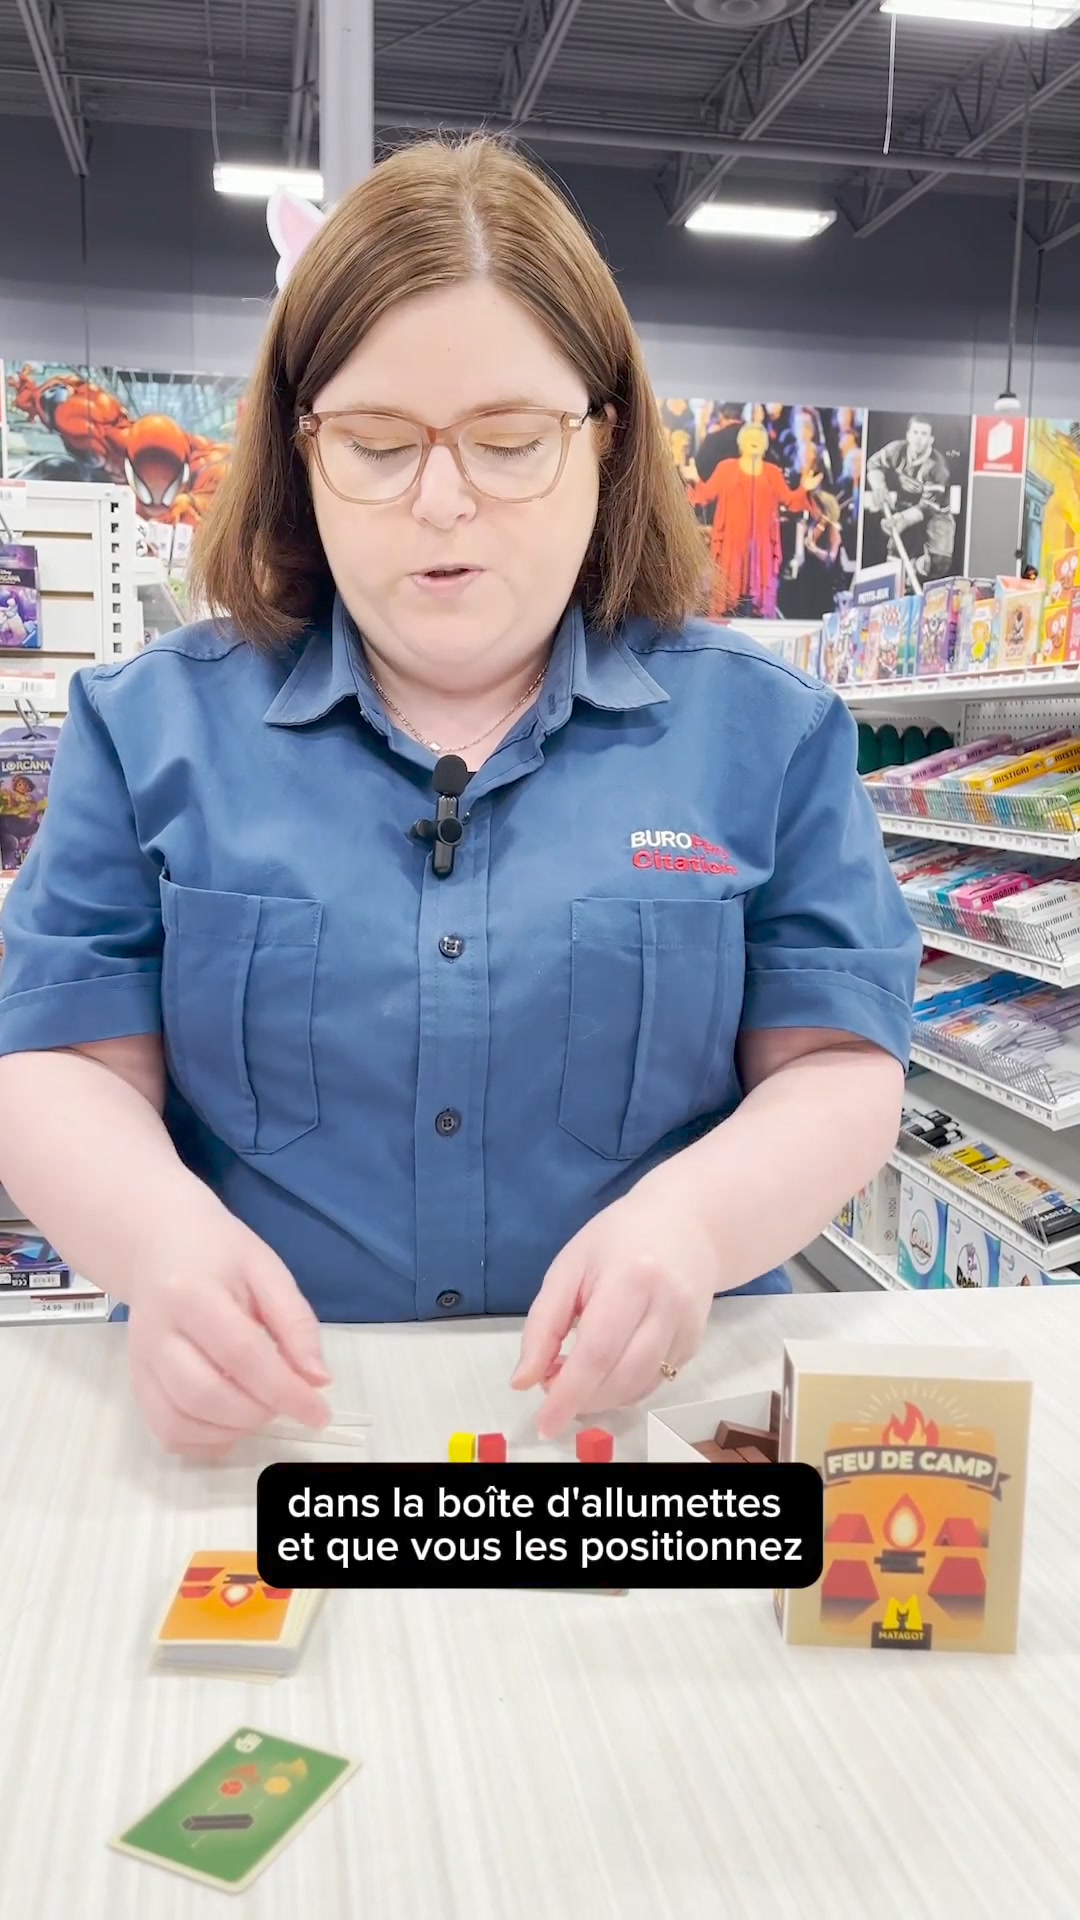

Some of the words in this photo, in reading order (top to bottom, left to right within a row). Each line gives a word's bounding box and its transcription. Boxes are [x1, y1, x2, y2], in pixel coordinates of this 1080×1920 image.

[1, 760, 51, 772] LORCANA
[632, 849, 738, 875] Citation
[827, 1451, 875, 1474] FEU
[880, 1450, 915, 1470] DE
[919, 1451, 993, 1478] CAMP
[878, 1631, 924, 1641] MATAGOT
